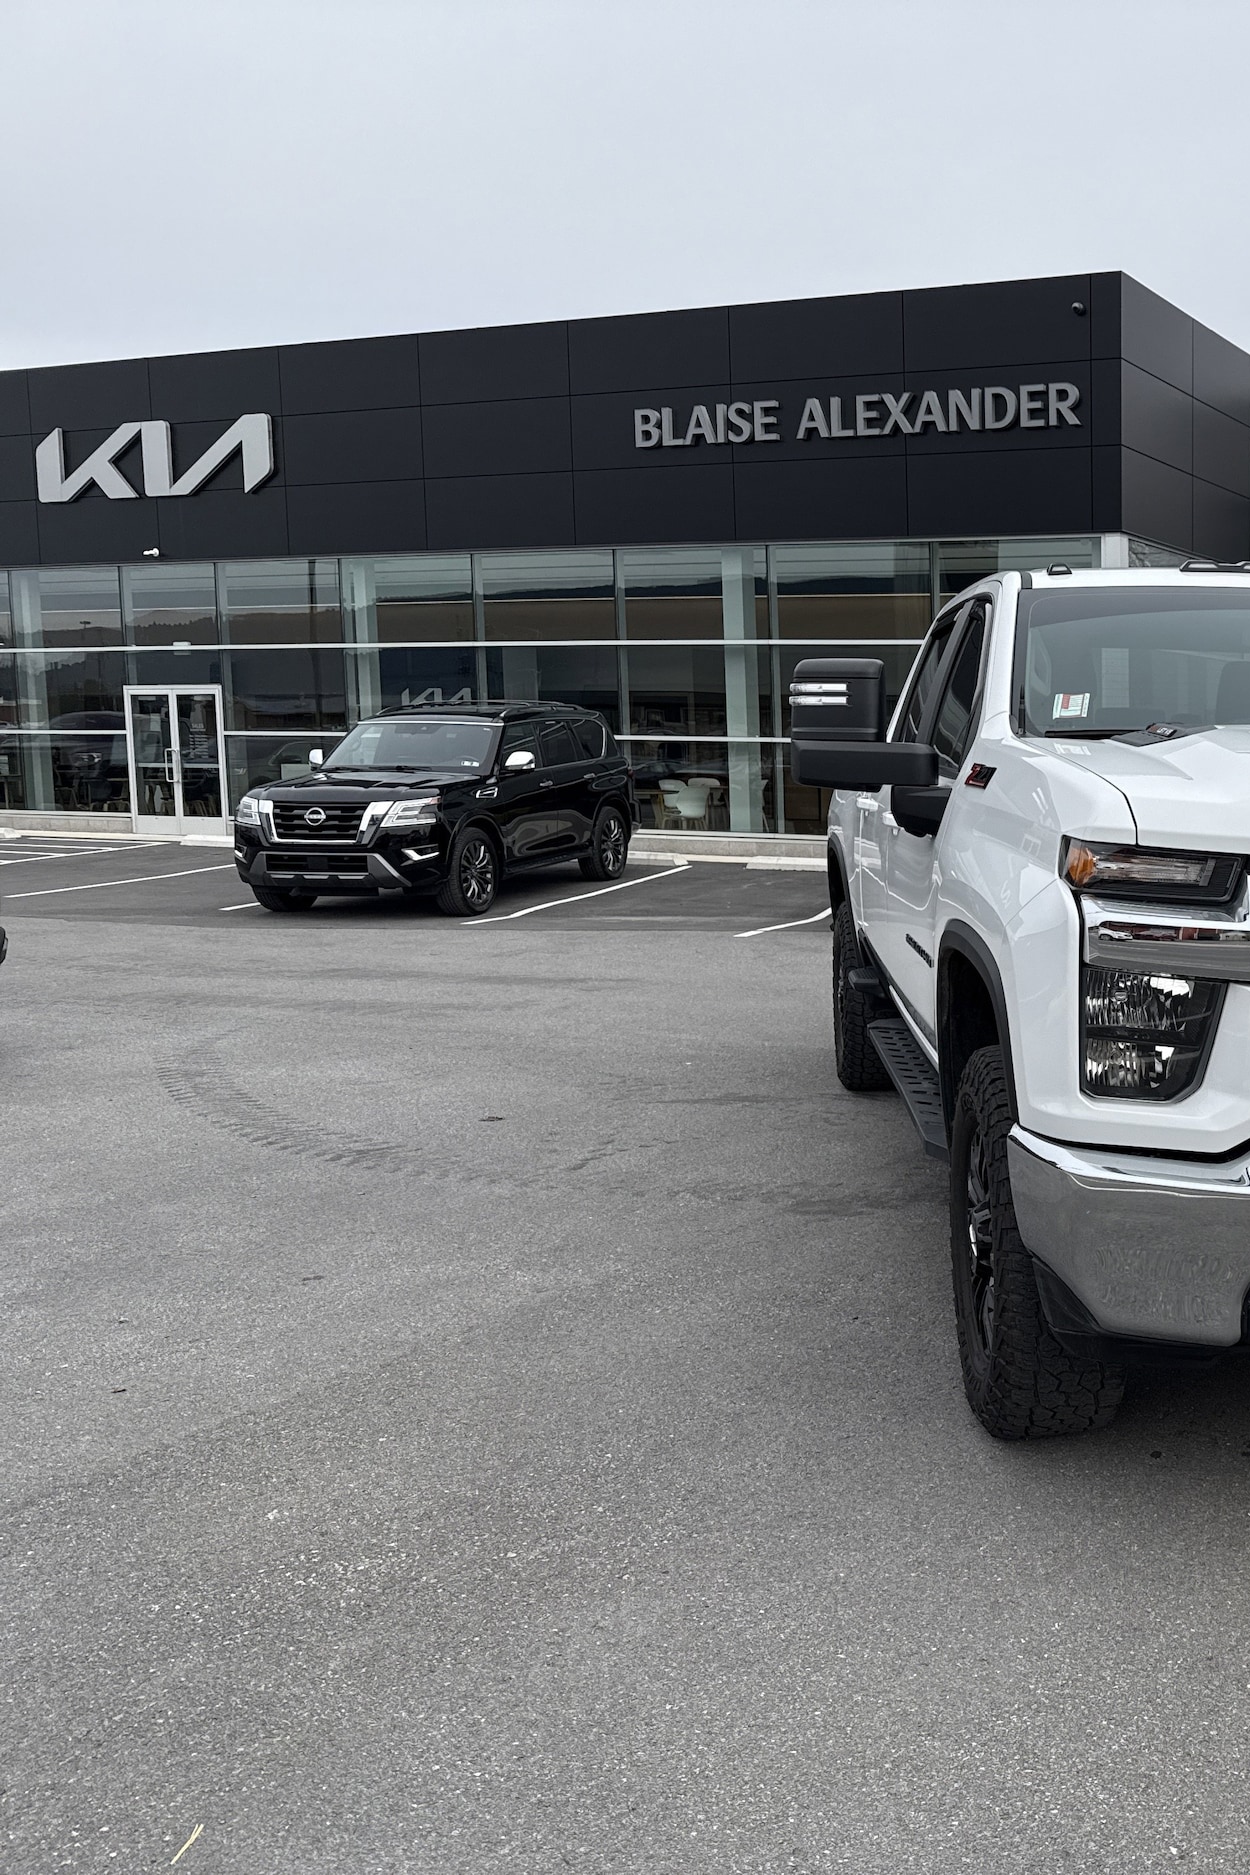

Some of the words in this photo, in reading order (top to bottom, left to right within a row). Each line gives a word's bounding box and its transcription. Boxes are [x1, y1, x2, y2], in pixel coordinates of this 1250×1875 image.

[634, 399, 781, 449] BLAISE
[796, 382, 1083, 440] ALEXANDER
[35, 412, 275, 503] KIA
